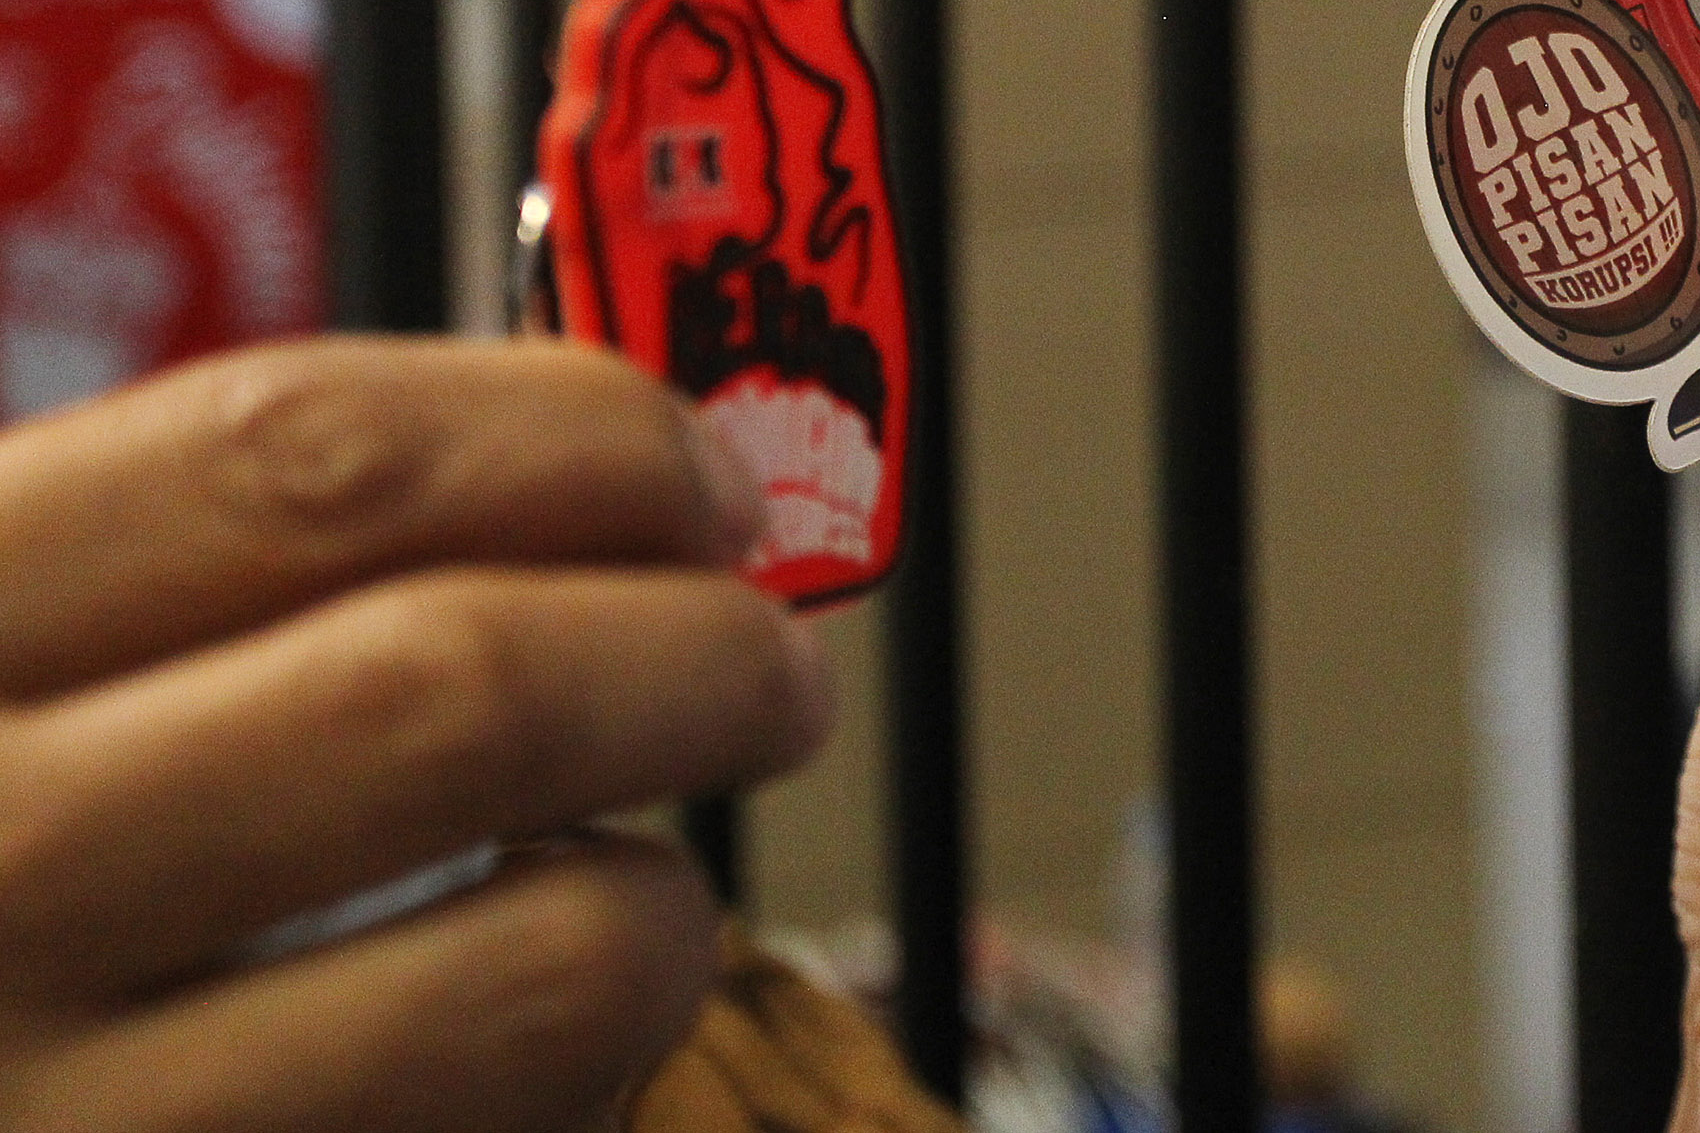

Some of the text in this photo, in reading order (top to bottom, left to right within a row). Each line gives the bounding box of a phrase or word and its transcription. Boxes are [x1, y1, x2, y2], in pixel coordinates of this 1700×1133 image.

[1461, 32, 1630, 174] OJO
[1477, 102, 1658, 229] PISAN
[1498, 148, 1675, 274] PISAN
[1535, 234, 1659, 303] KORUPSI
